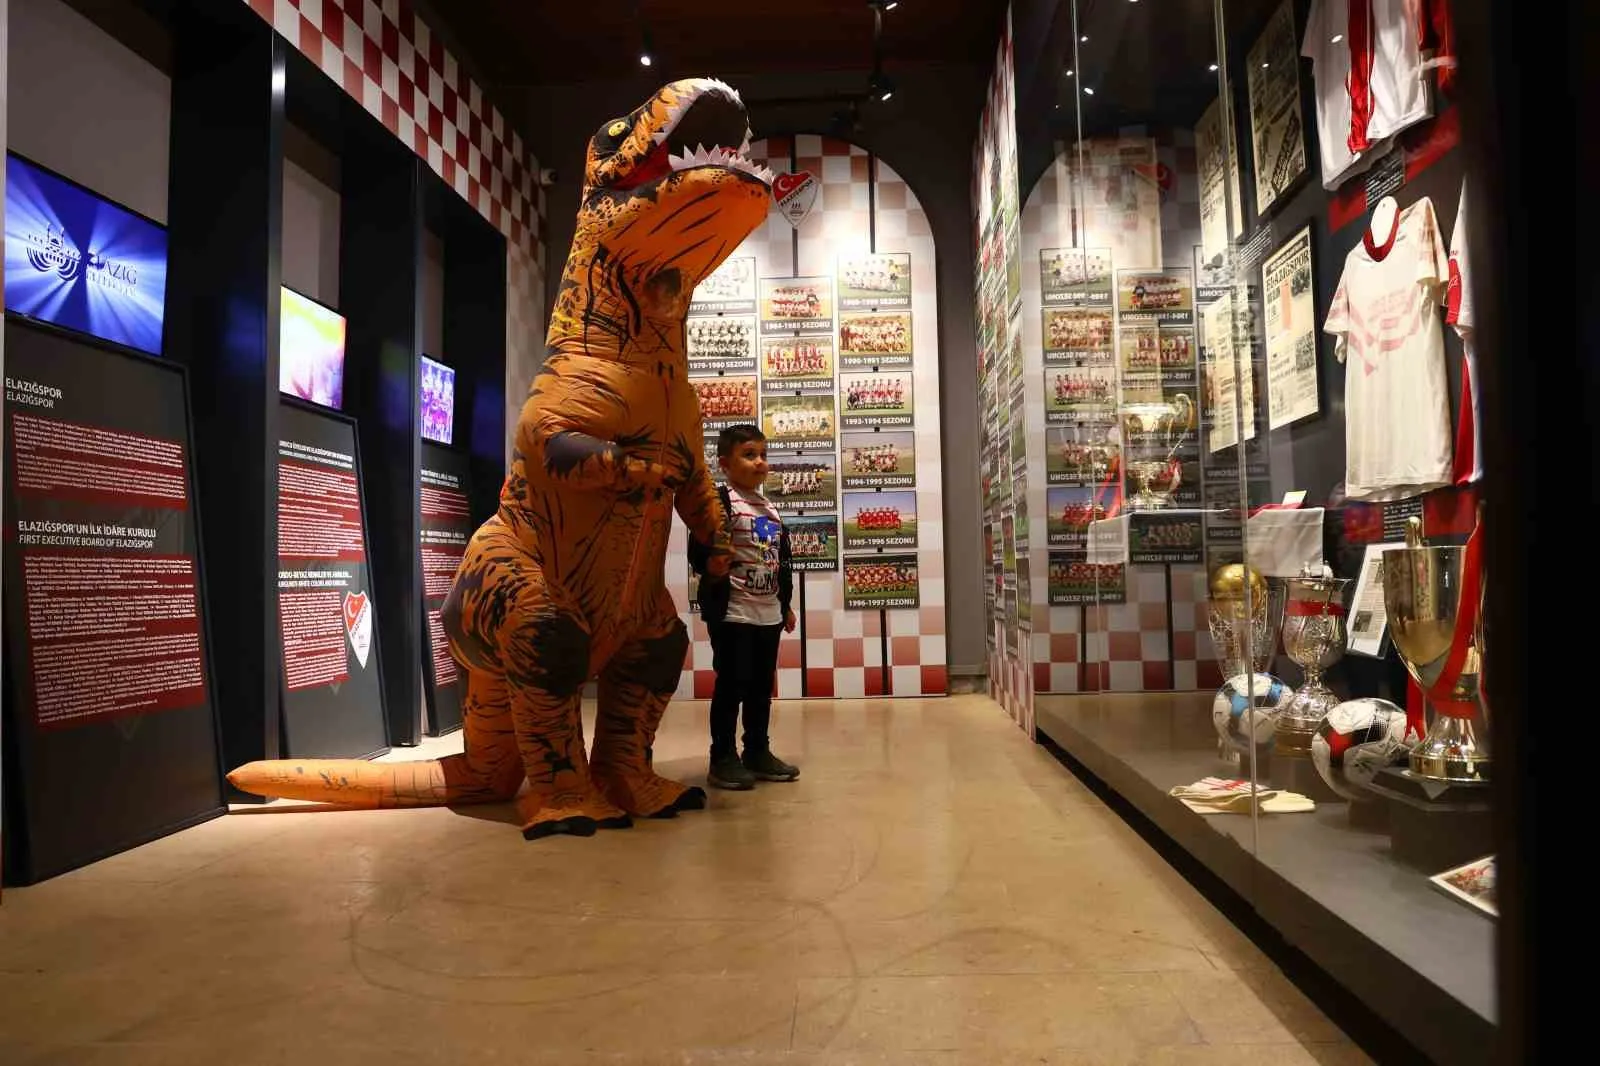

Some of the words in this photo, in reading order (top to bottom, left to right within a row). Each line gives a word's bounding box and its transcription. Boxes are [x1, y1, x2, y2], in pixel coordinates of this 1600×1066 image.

[801, 321, 831, 329] SEZONU
[726, 360, 755, 368] SEZONU
[6, 377, 62, 399] ELAZIĞSPOR
[7, 391, 54, 408] ELAZIĞSPOR
[882, 416, 912, 424] SEZONU
[804, 440, 833, 448] SEZONU
[884, 477, 913, 485] SEZONU
[805, 500, 834, 508] SEZONU
[90, 523, 102, 535] İLK
[128, 527, 156, 538] KURULU
[20, 534, 41, 545] FIRST
[42, 535, 80, 546] EXECUTIVE
[82, 537, 105, 547] BOARD
[106, 538, 115, 547] OF
[886, 537, 915, 545] SEZONU
